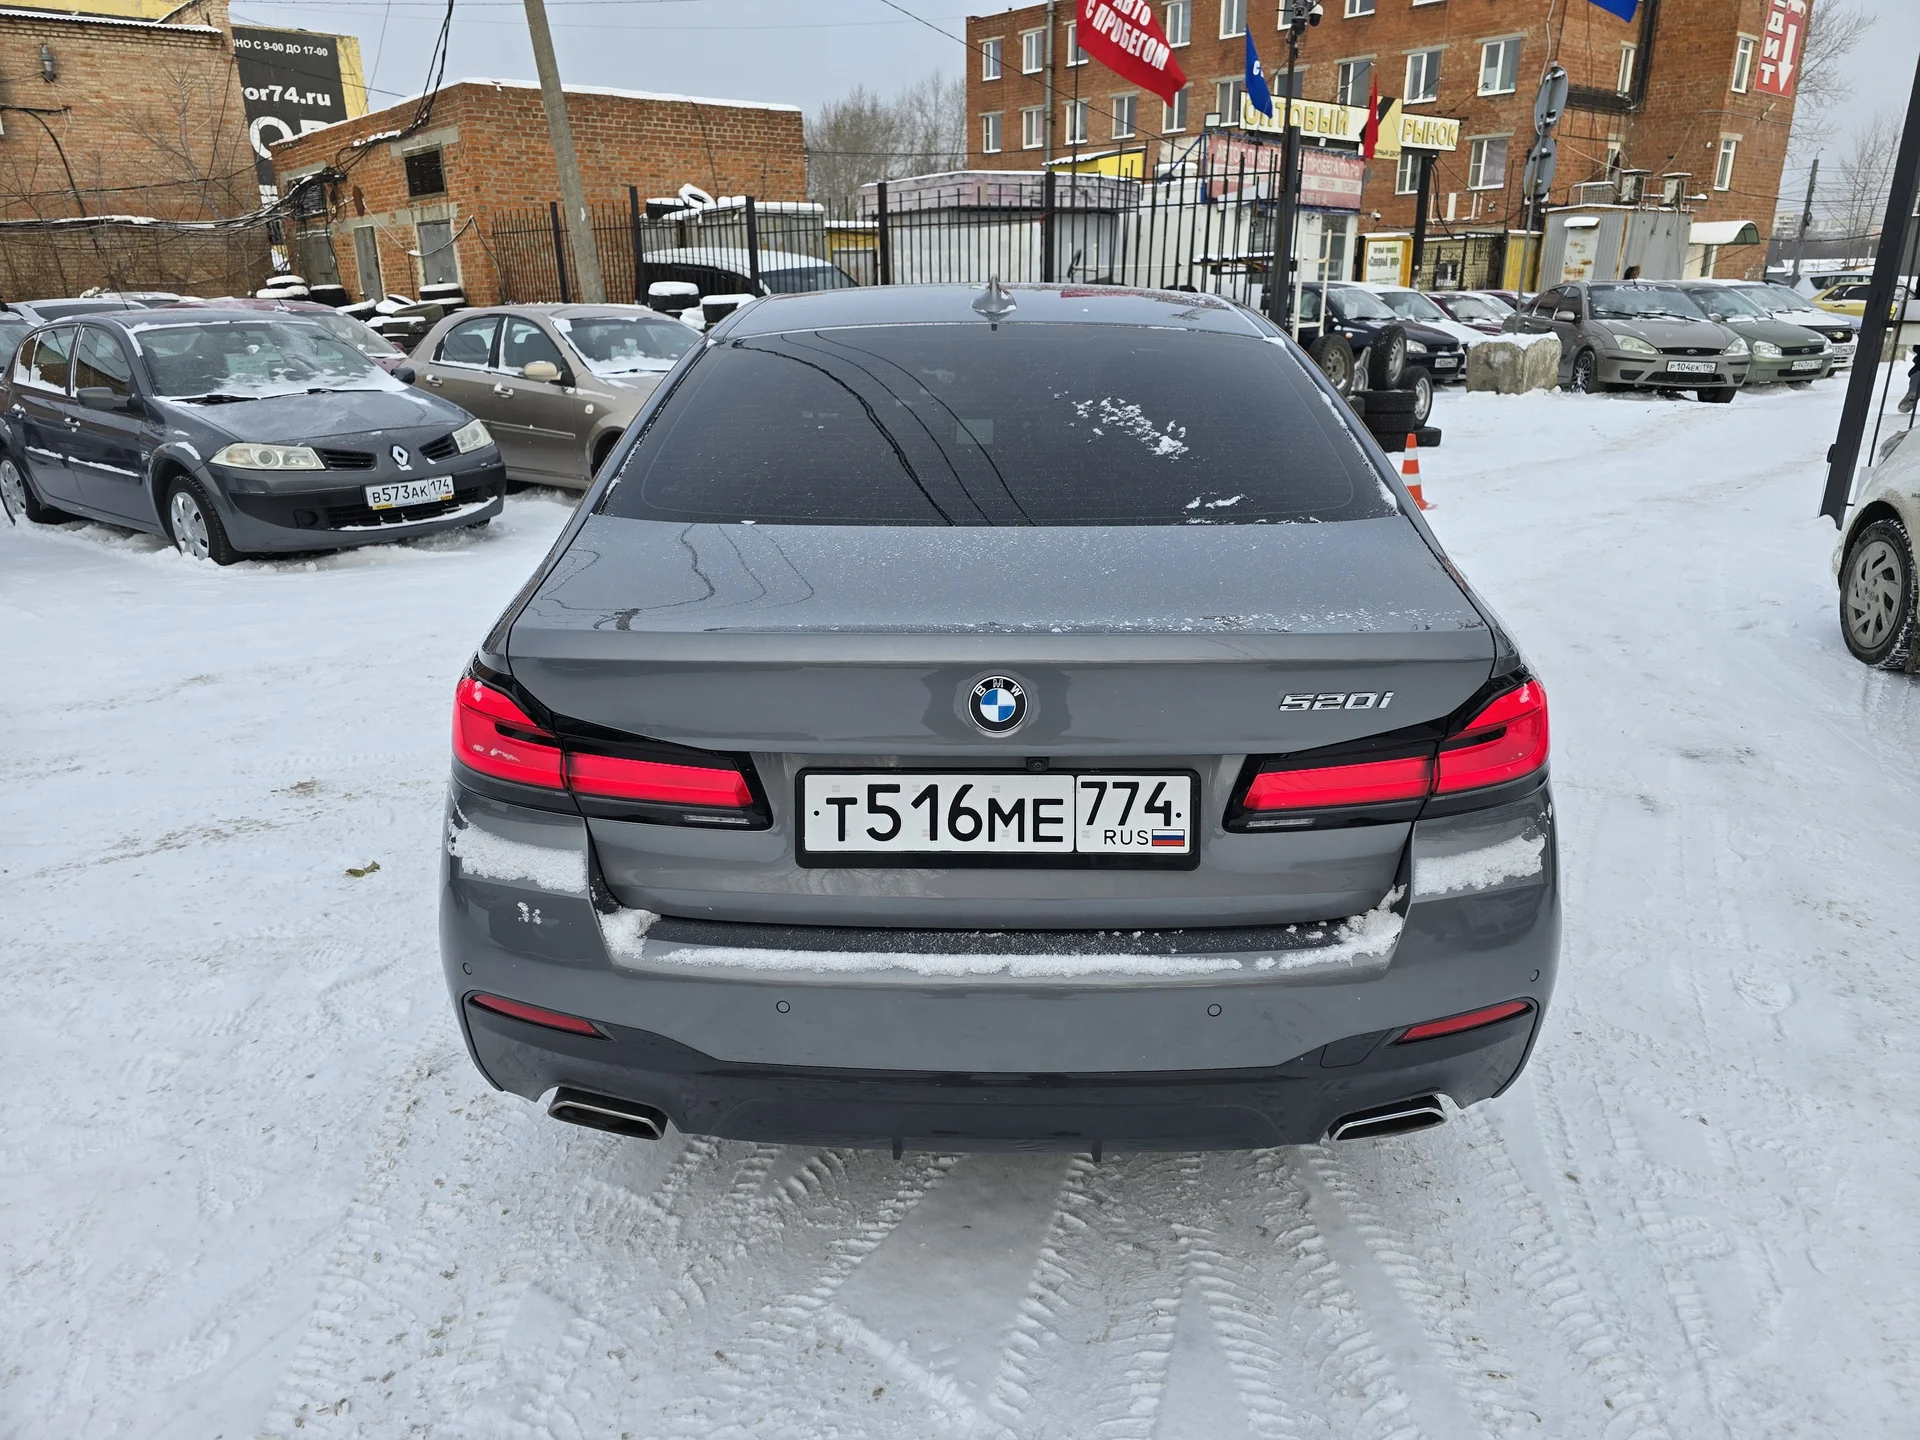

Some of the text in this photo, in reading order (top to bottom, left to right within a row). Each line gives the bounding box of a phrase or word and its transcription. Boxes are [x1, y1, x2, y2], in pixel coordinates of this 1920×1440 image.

[1085, 0, 1170, 71] С ПРОБЕГОМ
[253, 41, 262, 50] С
[263, 42, 284, 52] 9-00
[286, 44, 301, 54] ДО
[303, 46, 328, 56] 17-00
[241, 84, 331, 106] or74.ru
[1402, 118, 1459, 147] РЫНОК
[372, 485, 428, 503] В573АК
[430, 479, 450, 492] 174
[975, 678, 1023, 697] BMW
[1279, 691, 1394, 711] 520i
[825, 781, 1172, 842] Т516МЕ 774
[1104, 829, 1149, 846] RUS
